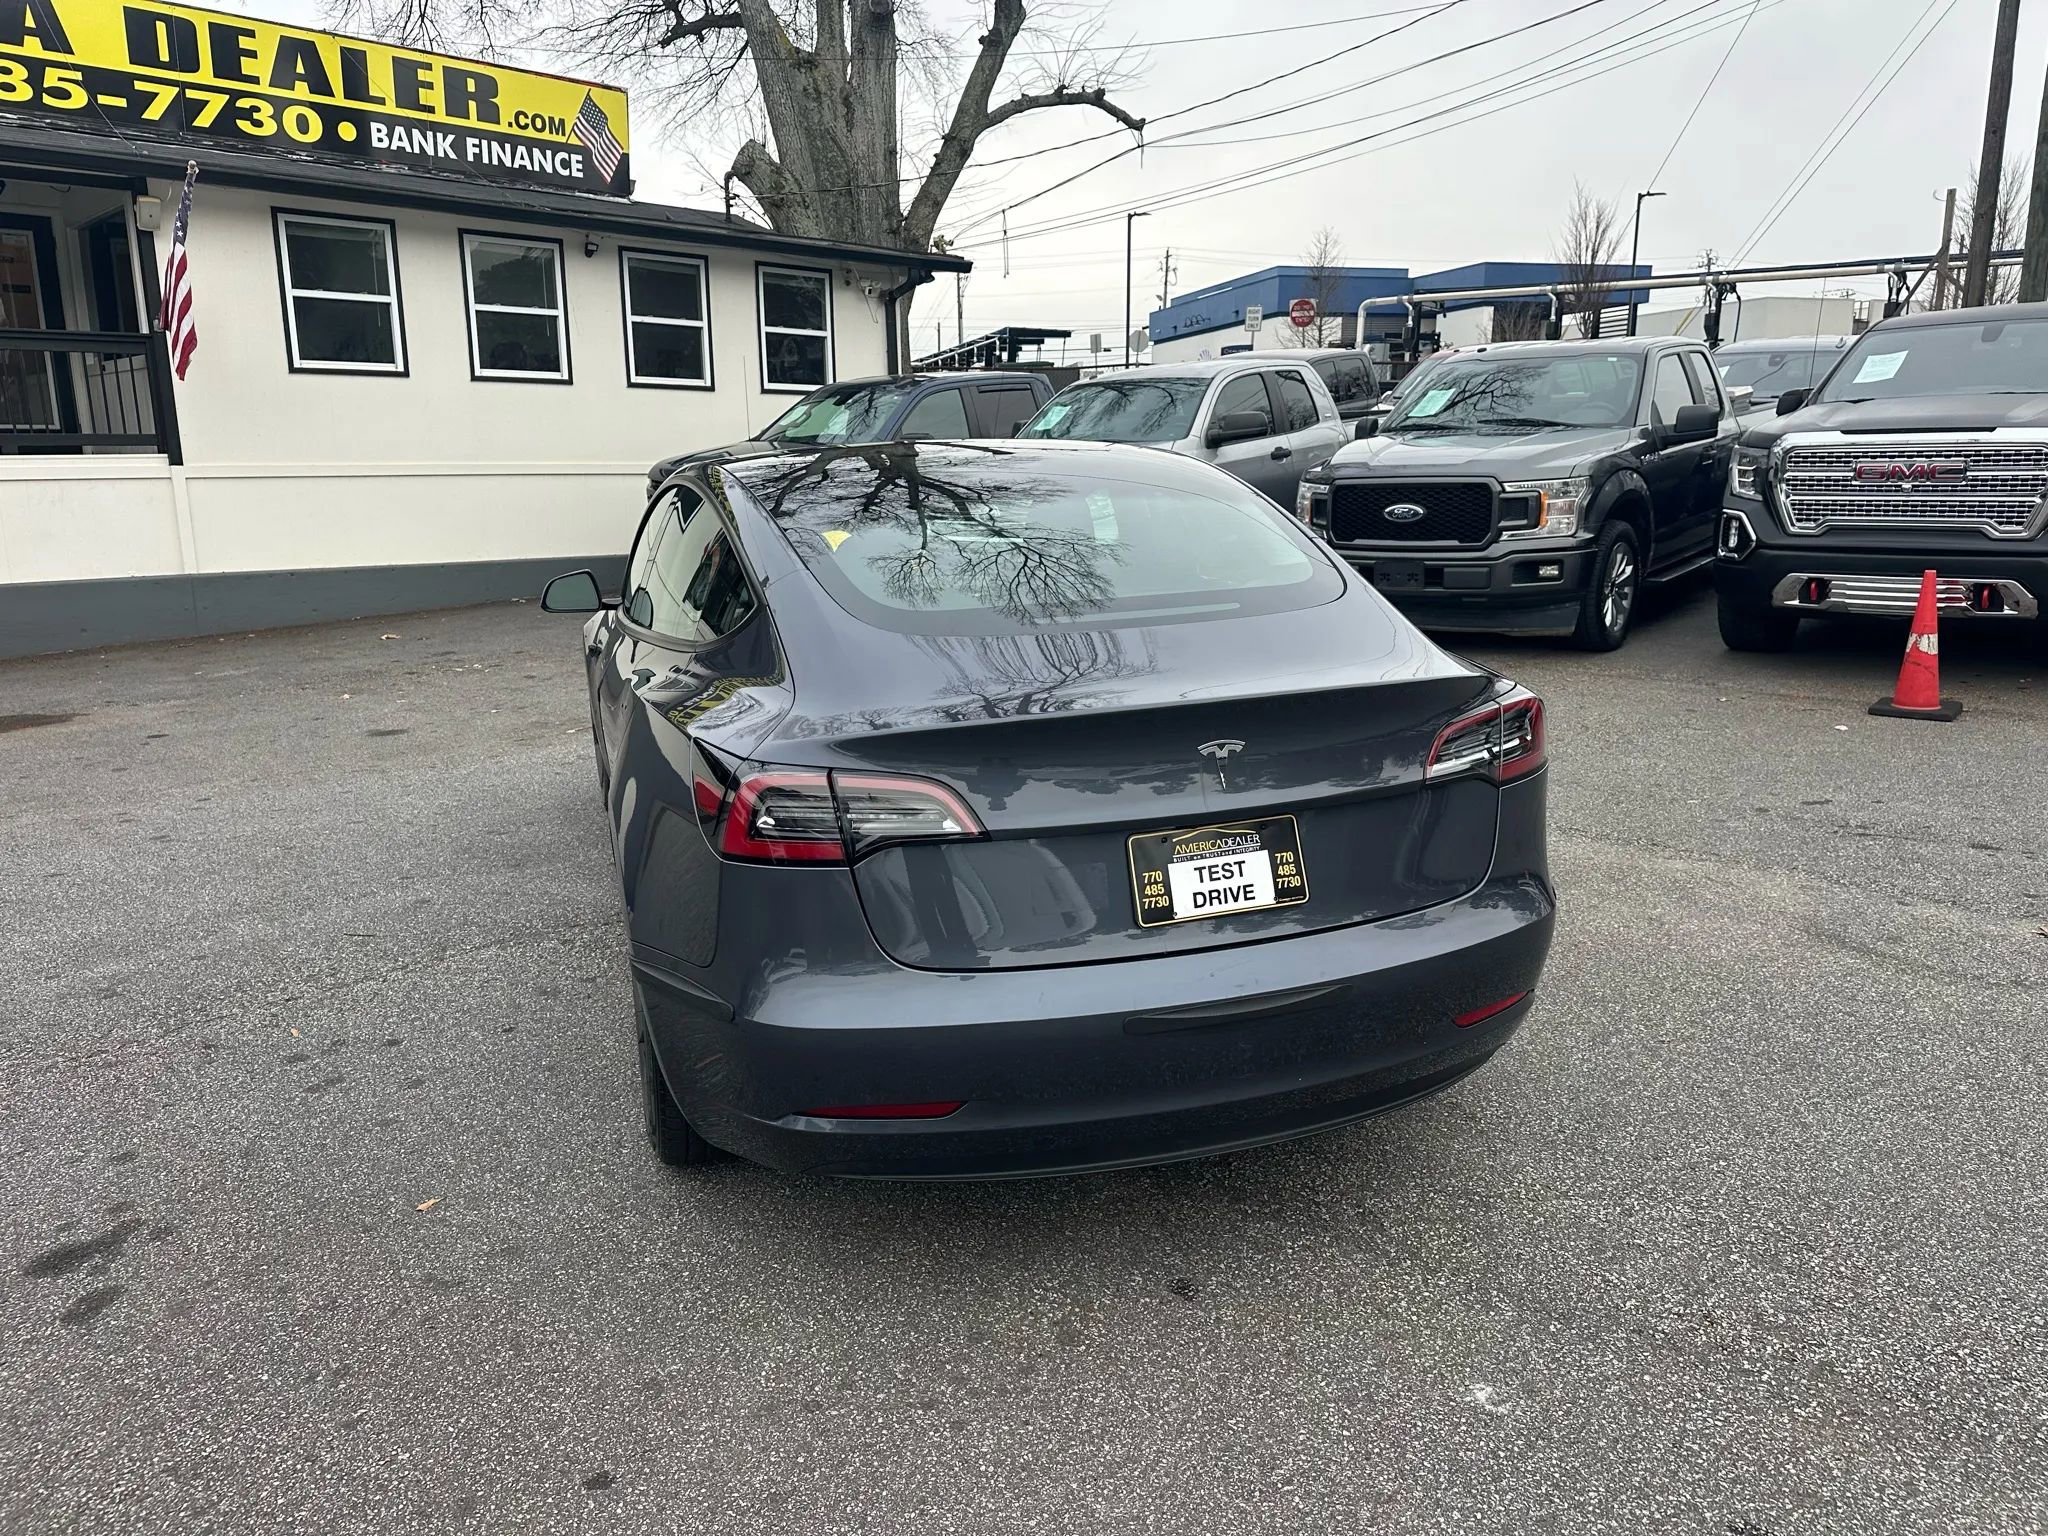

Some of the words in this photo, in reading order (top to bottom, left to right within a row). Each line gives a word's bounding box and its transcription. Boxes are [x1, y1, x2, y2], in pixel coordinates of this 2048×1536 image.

[123, 5, 501, 125] DEALER
[507, 110, 567, 137] .COM
[370, 121, 457, 159] BANK
[466, 136, 584, 178] FINANCE
[1855, 462, 1965, 481] GMC
[1174, 833, 1261, 855] AMERICADEALER
[1202, 851, 1221, 859] TRUST
[1233, 846, 1260, 854] INTEGRITY
[1274, 851, 1294, 864] 770
[1194, 860, 1247, 884] TEST
[1277, 863, 1297, 876] 485
[1142, 870, 1163, 885] 770
[1276, 875, 1302, 889] 7730
[1144, 884, 1165, 897] 485
[1192, 884, 1256, 909] DRIVE
[1142, 895, 1170, 910] 7730
